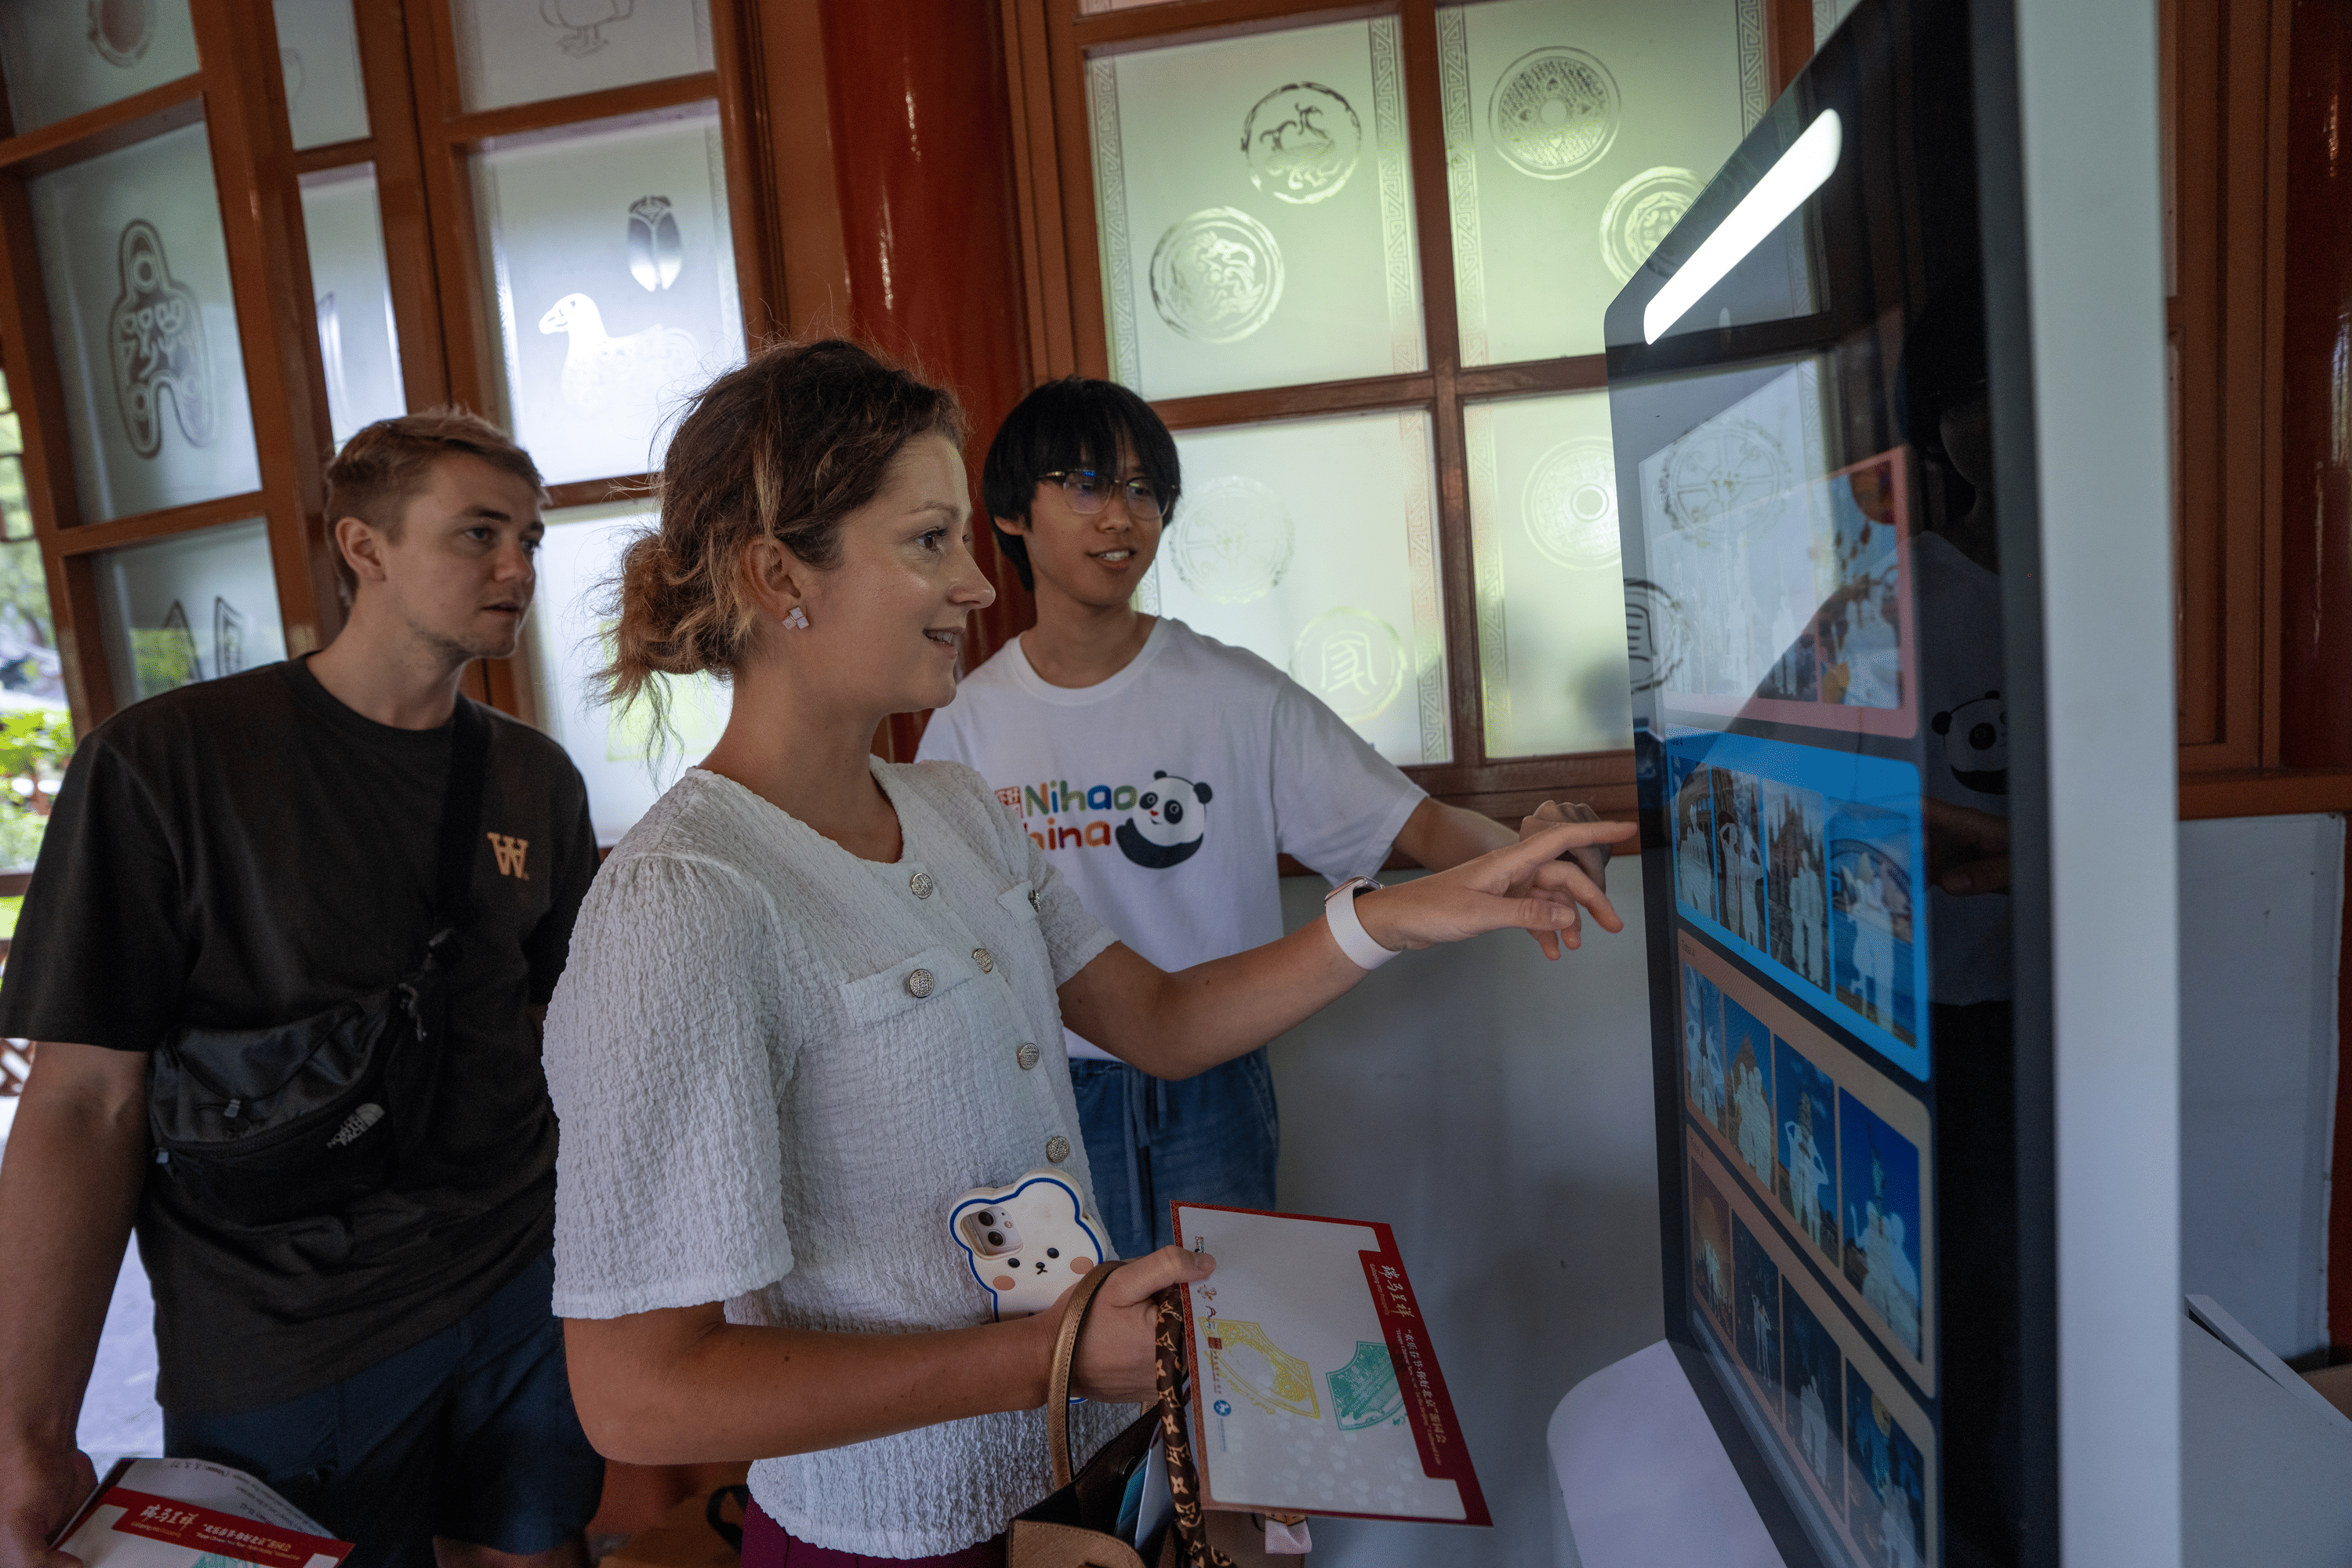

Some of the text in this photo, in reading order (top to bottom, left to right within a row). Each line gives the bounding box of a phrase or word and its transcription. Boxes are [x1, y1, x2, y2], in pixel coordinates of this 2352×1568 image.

[1025, 780, 1138, 817] Nihao
[1682, 940, 1691, 956] Total
[1370, 1263, 1380, 1284] Galloping
[1380, 1294, 1390, 1316] Prosperity
[1377, 1265, 1415, 1318] 瑞马呈祥
